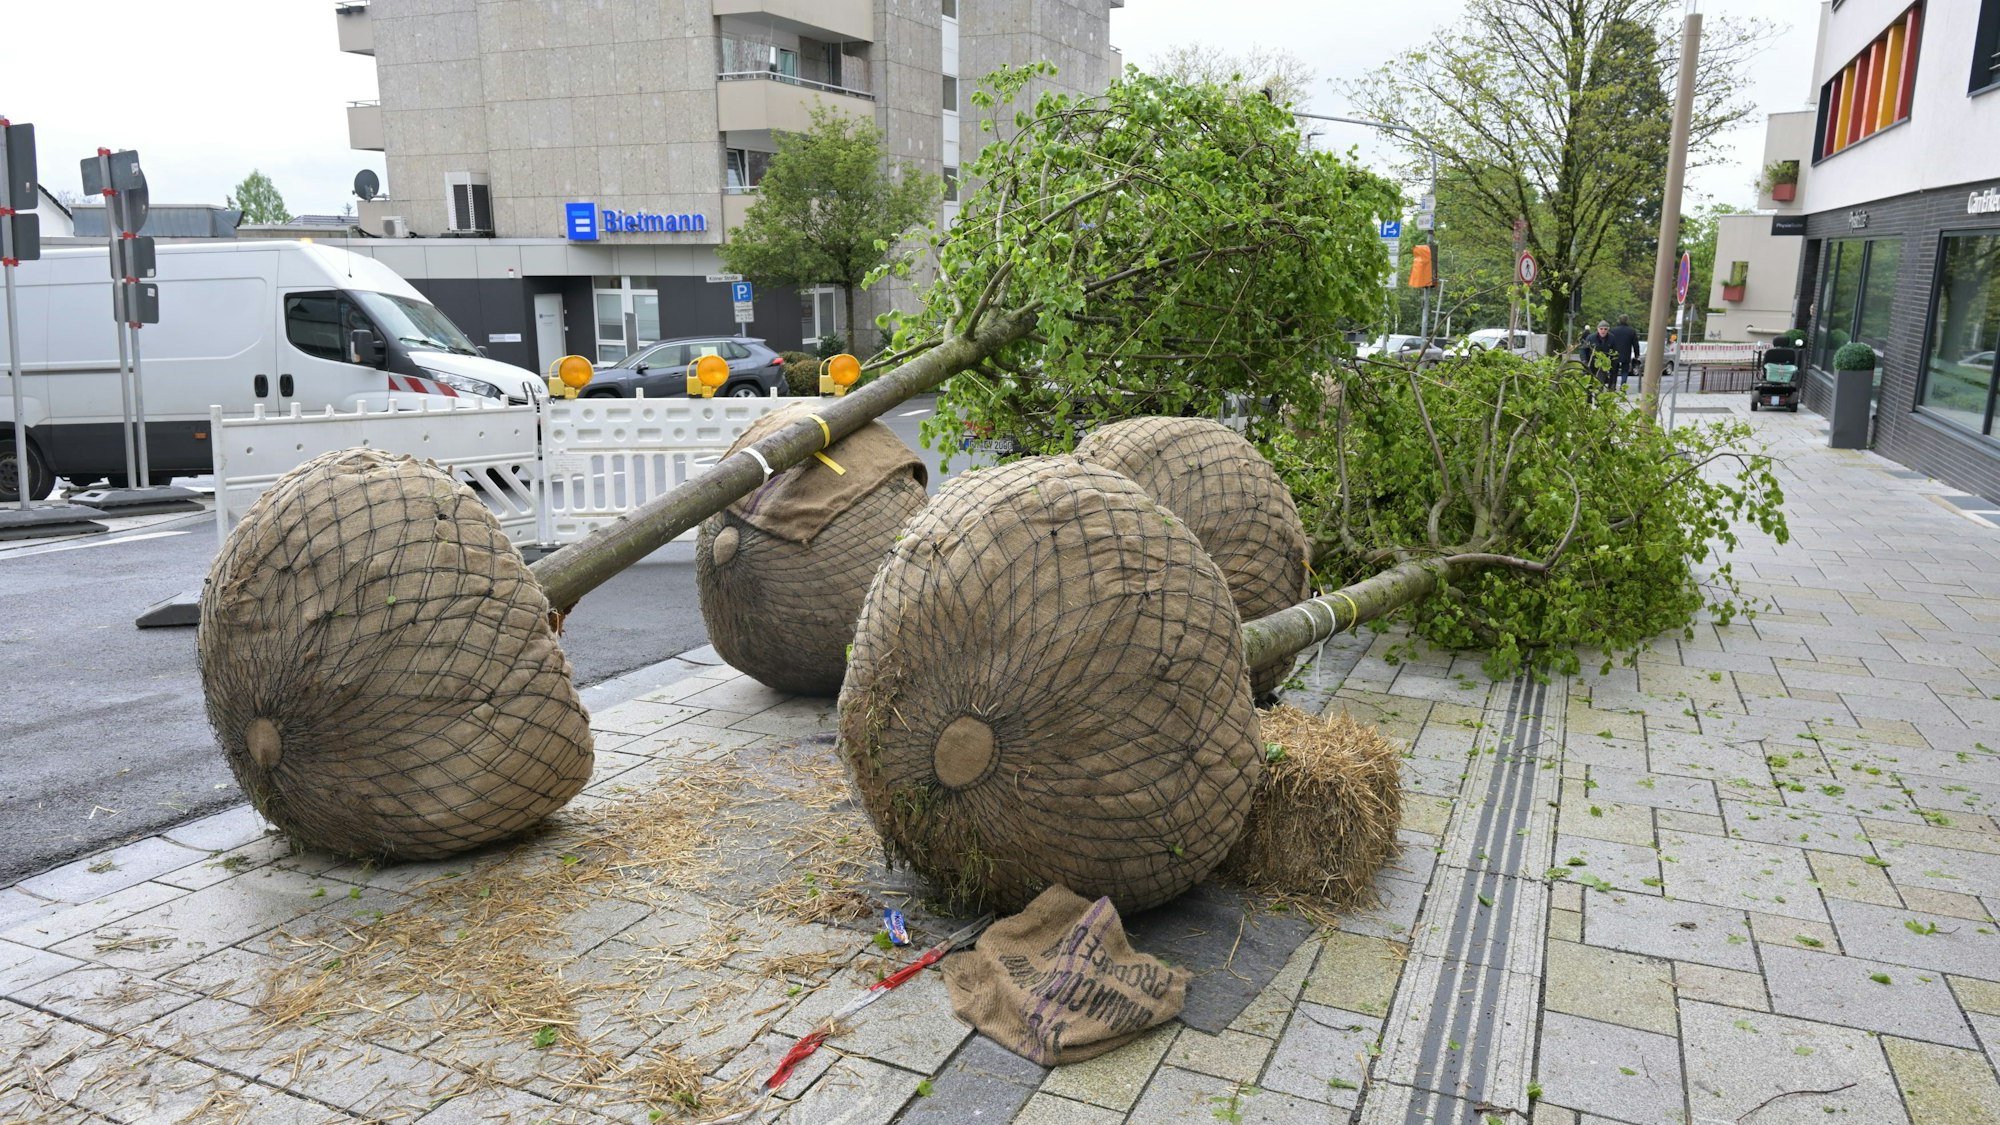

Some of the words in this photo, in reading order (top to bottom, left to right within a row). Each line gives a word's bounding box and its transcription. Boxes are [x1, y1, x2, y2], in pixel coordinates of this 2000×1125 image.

[602, 210, 706, 232] Bietmann
[737, 285, 747, 300] P
[1078, 935, 1174, 999] PRODUCE
